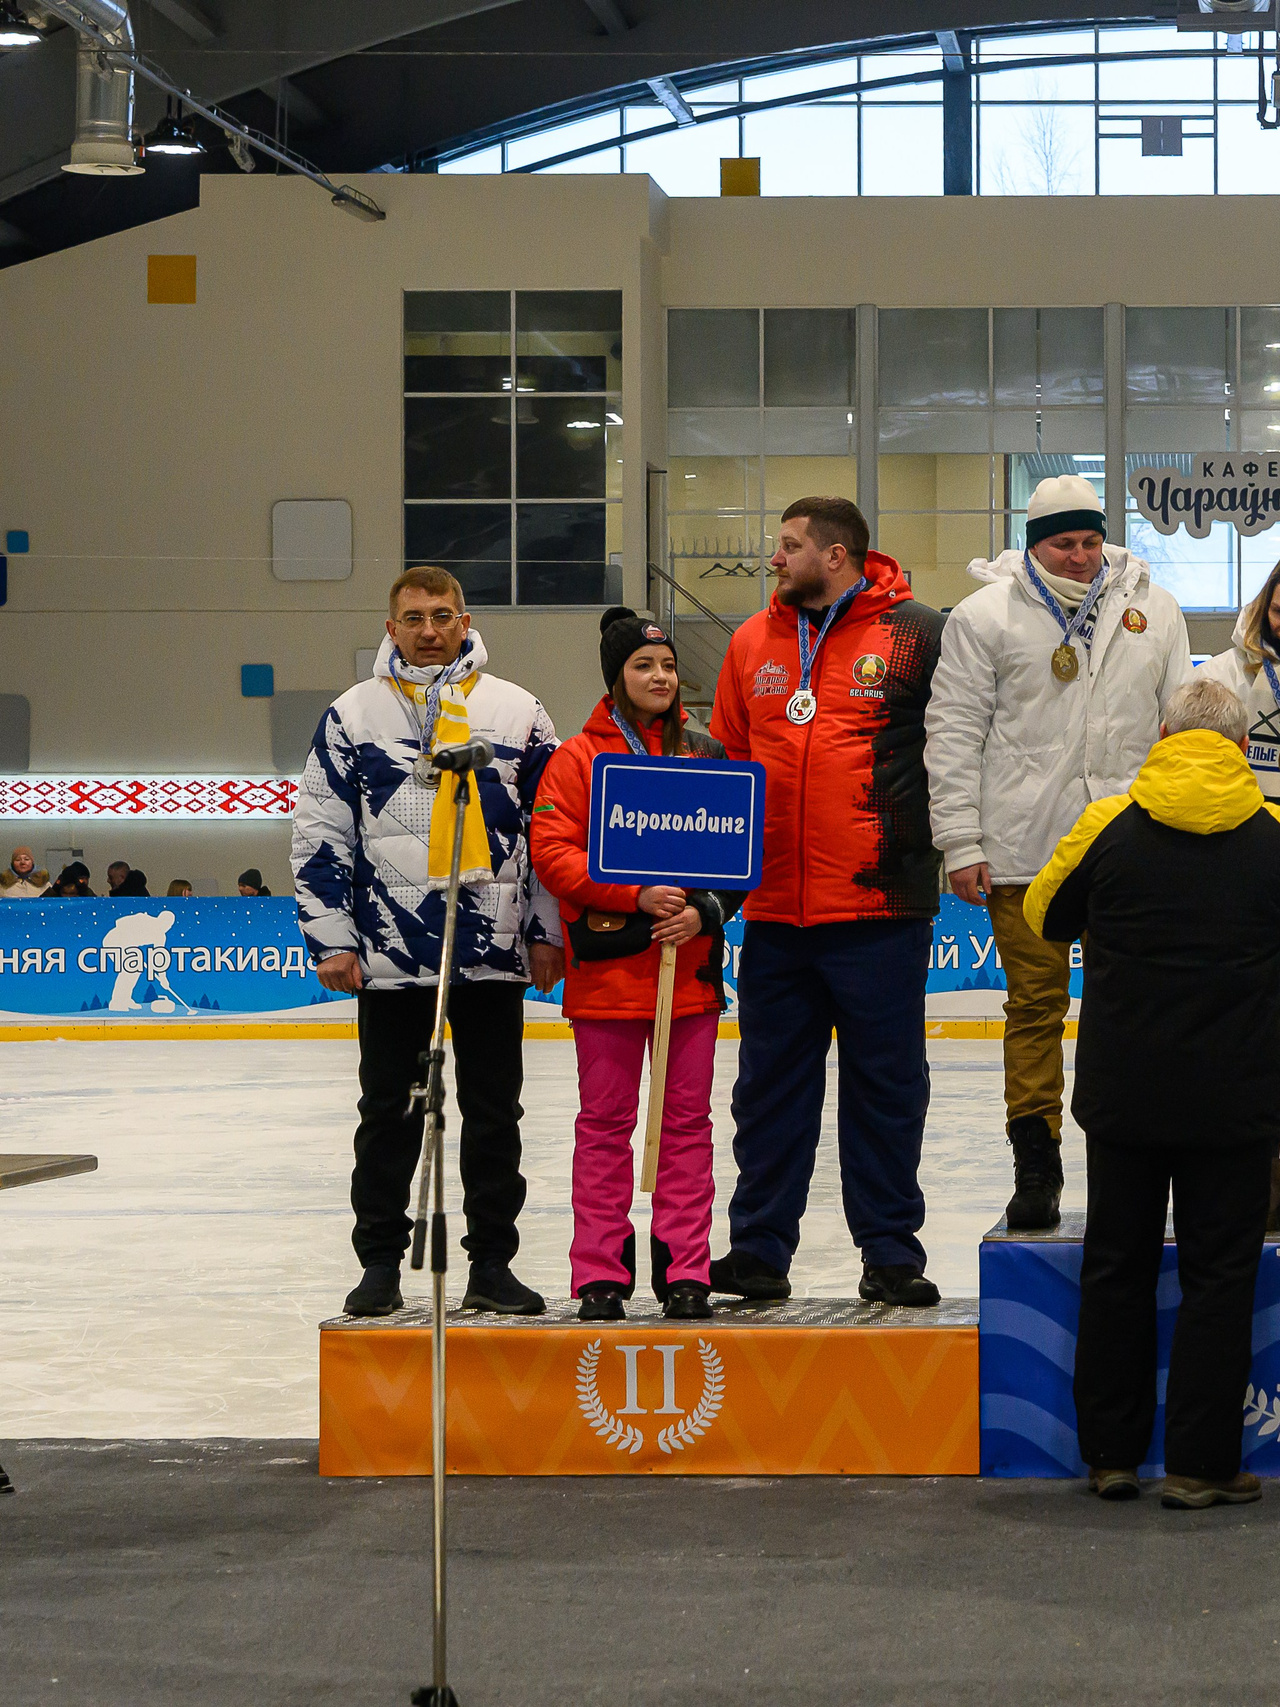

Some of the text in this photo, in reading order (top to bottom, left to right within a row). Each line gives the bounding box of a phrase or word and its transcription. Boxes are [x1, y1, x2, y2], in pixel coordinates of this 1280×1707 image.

[1203, 461, 1279, 478] КАФЕ
[849, 688, 884, 699] BELARUS
[608, 803, 745, 837] Агрохолдинг
[615, 1344, 685, 1415] II
